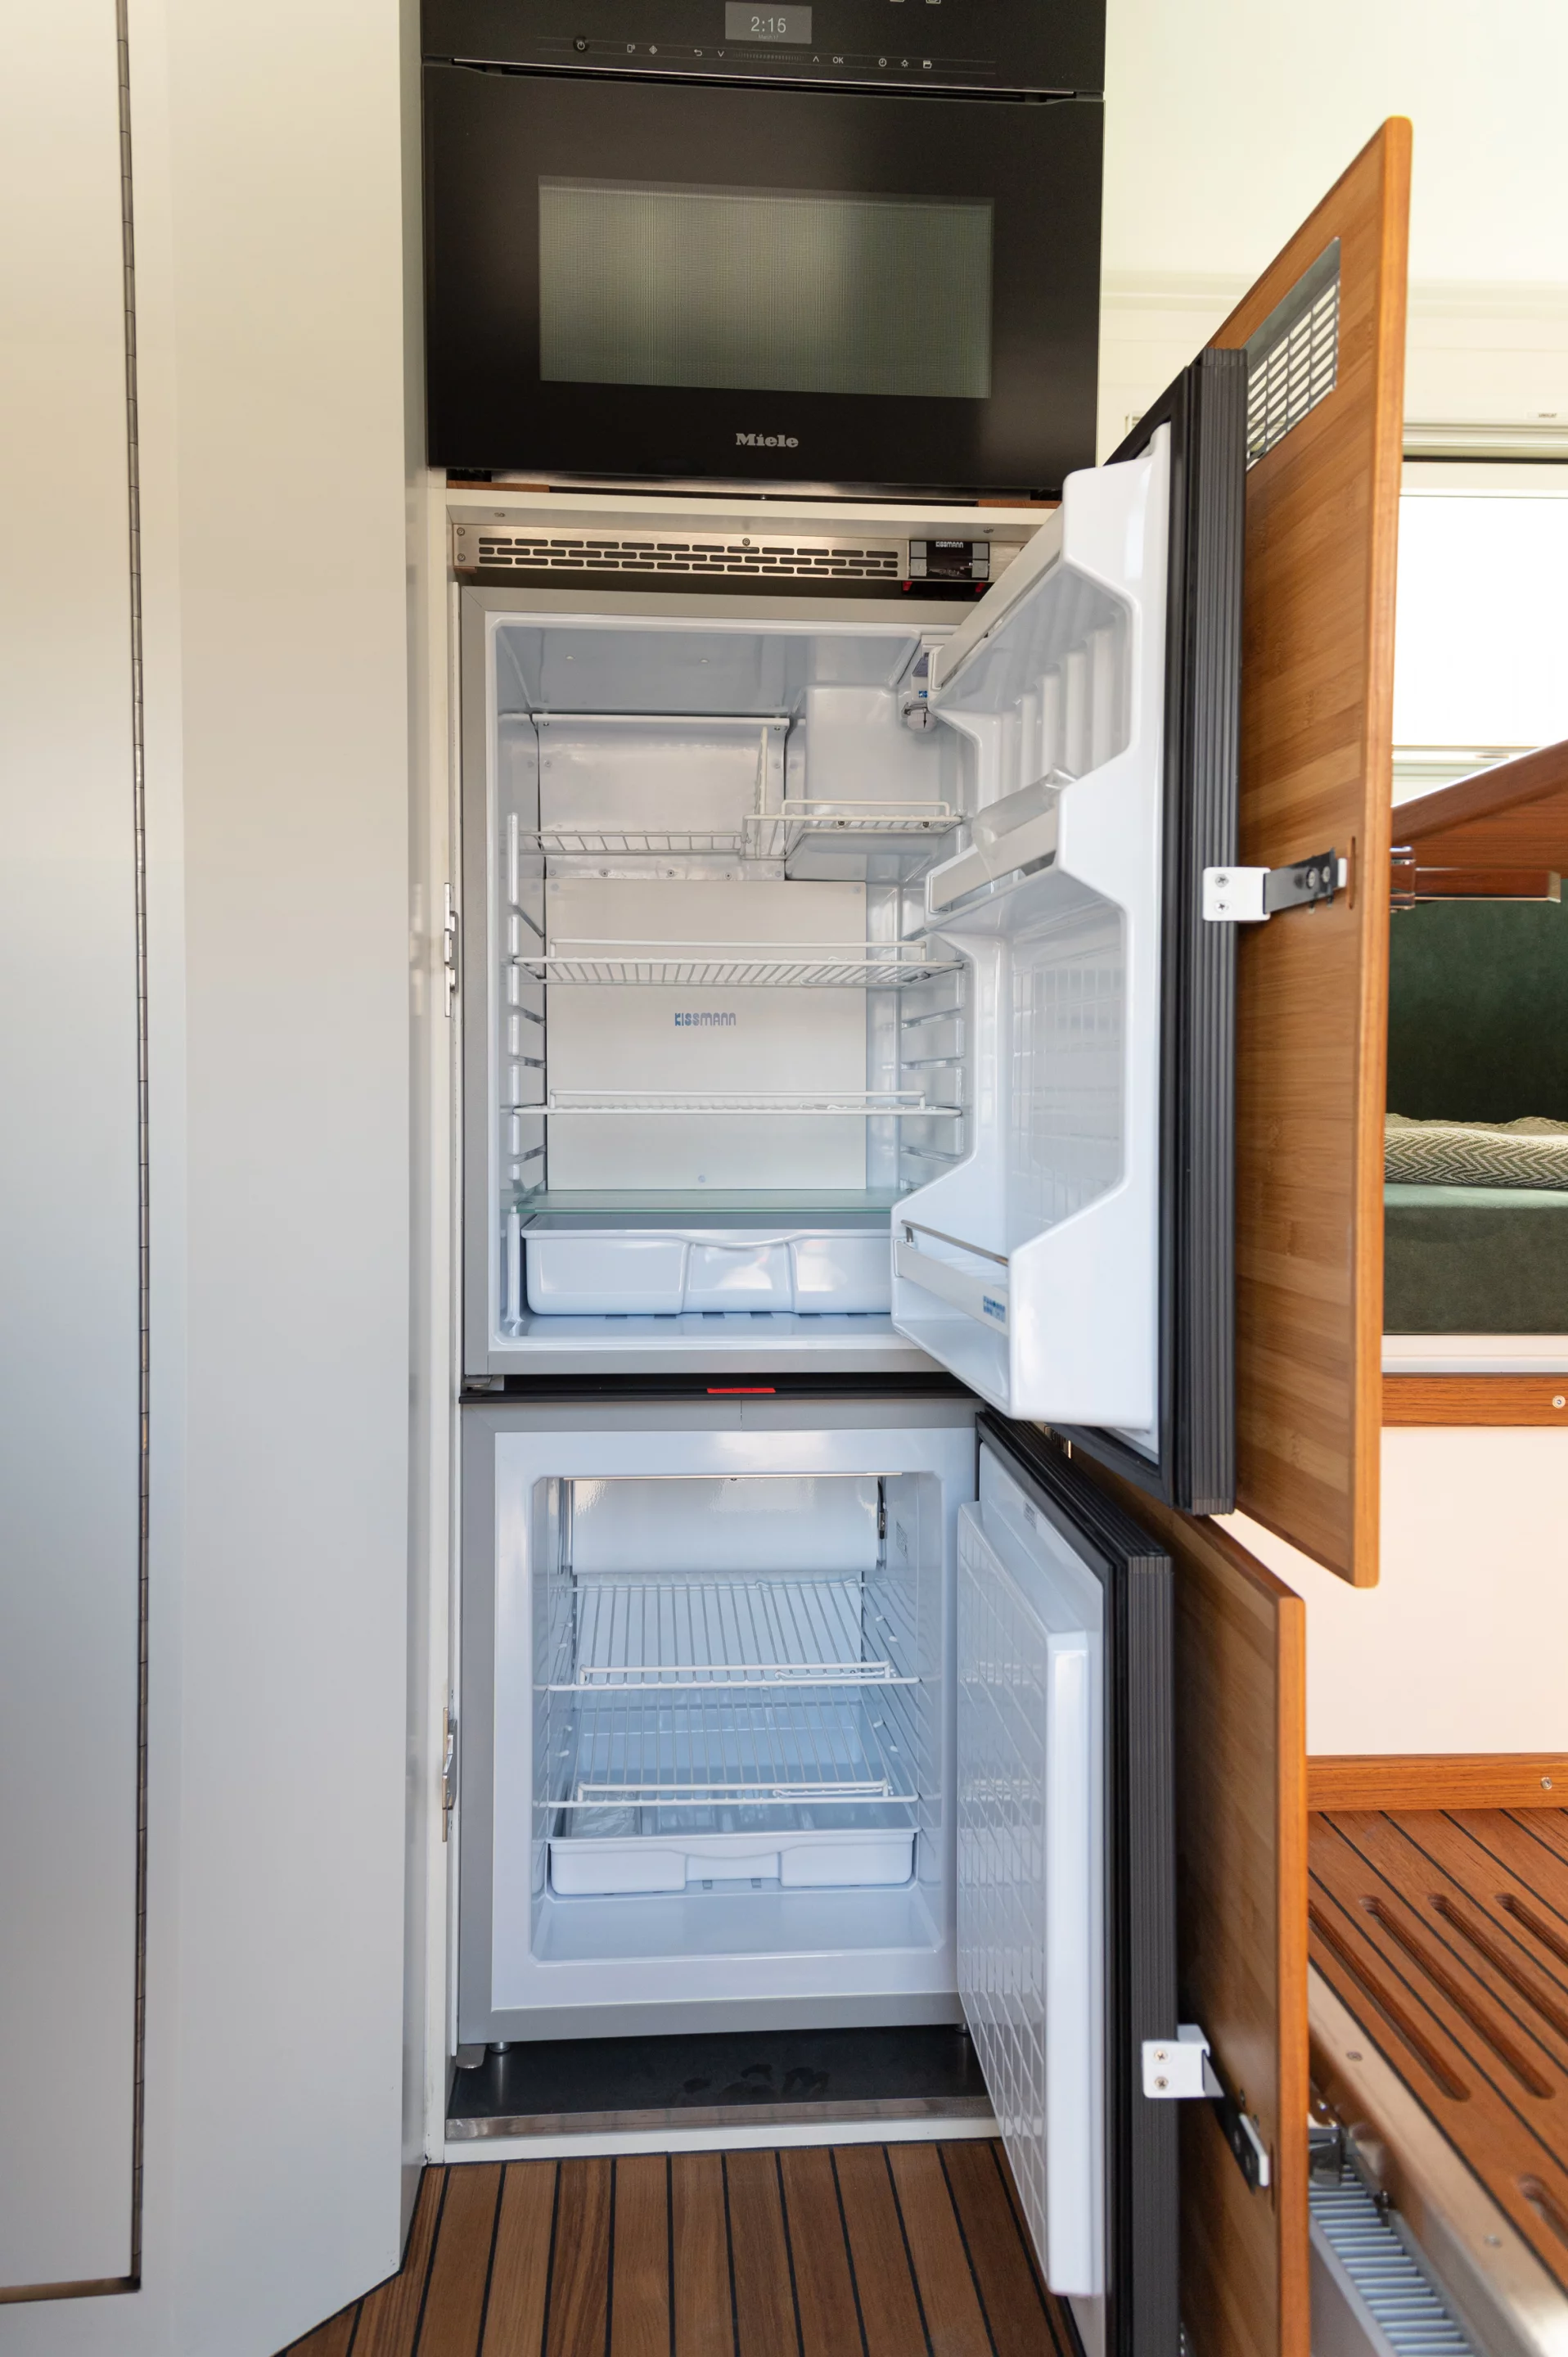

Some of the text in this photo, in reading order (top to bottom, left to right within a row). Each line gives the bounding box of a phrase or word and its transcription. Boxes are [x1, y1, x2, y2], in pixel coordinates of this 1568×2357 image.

[750, 16, 786, 34] 2:15
[832, 56, 844, 65] OK
[736, 433, 799, 448] Miele
[674, 1012, 737, 1026] KISSMANN
